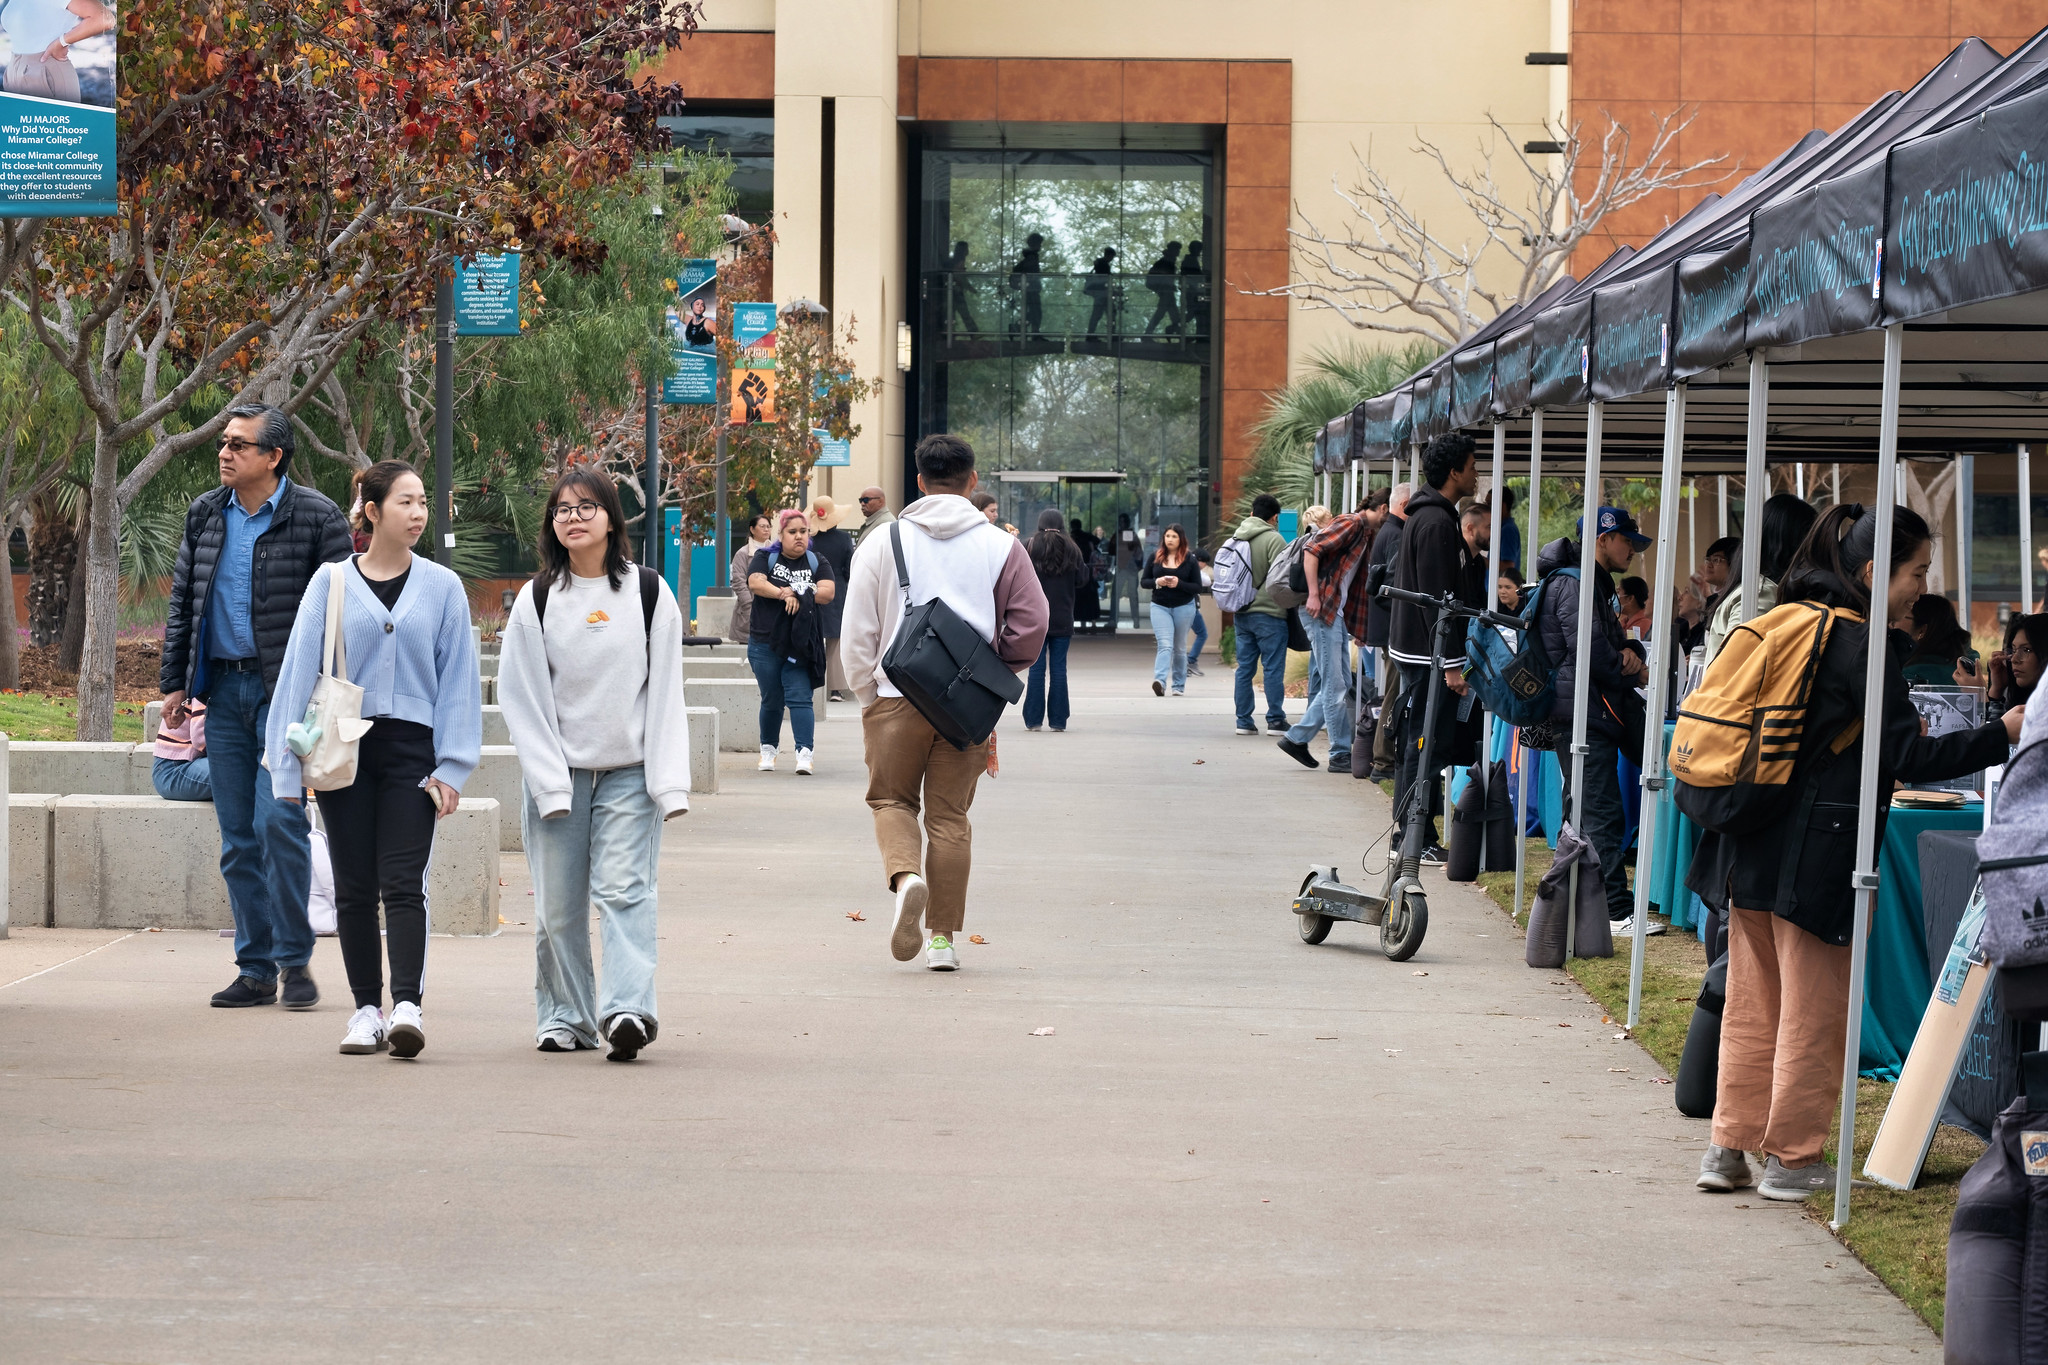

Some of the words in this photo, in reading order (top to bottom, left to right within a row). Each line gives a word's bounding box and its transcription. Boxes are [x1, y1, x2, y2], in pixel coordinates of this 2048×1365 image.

[34, 116, 70, 124] MAJORS
[1, 126, 20, 135] Why
[22, 126, 37, 134] Did
[39, 126, 54, 134] You
[57, 126, 88, 134] Choose
[8, 136, 44, 144] Miramar
[46, 136, 82, 145] College?
[1, 151, 26, 159] chose
[66, 152, 98, 161] College
[2, 162, 11, 170] its
[13, 162, 53, 170] close-knit
[55, 162, 103, 171] community
[7, 172, 21, 180] the
[23, 172, 60, 180] excellent
[0, 182, 19, 192] they
[21, 182, 41, 190] offer
[8, 192, 26, 200] with
[1899, 196, 1922, 286] SAN
[1920, 188, 1957, 274] DIEGO
[1954, 167, 2014, 264] MIRAMAR
[773, 563, 791, 575] DEA
[792, 569, 812, 577] WITH
[774, 570, 813, 583] YOURSLF.
[1675, 764, 1691, 774] adidas
[1958, 1034, 1993, 1080] OLLEGE
